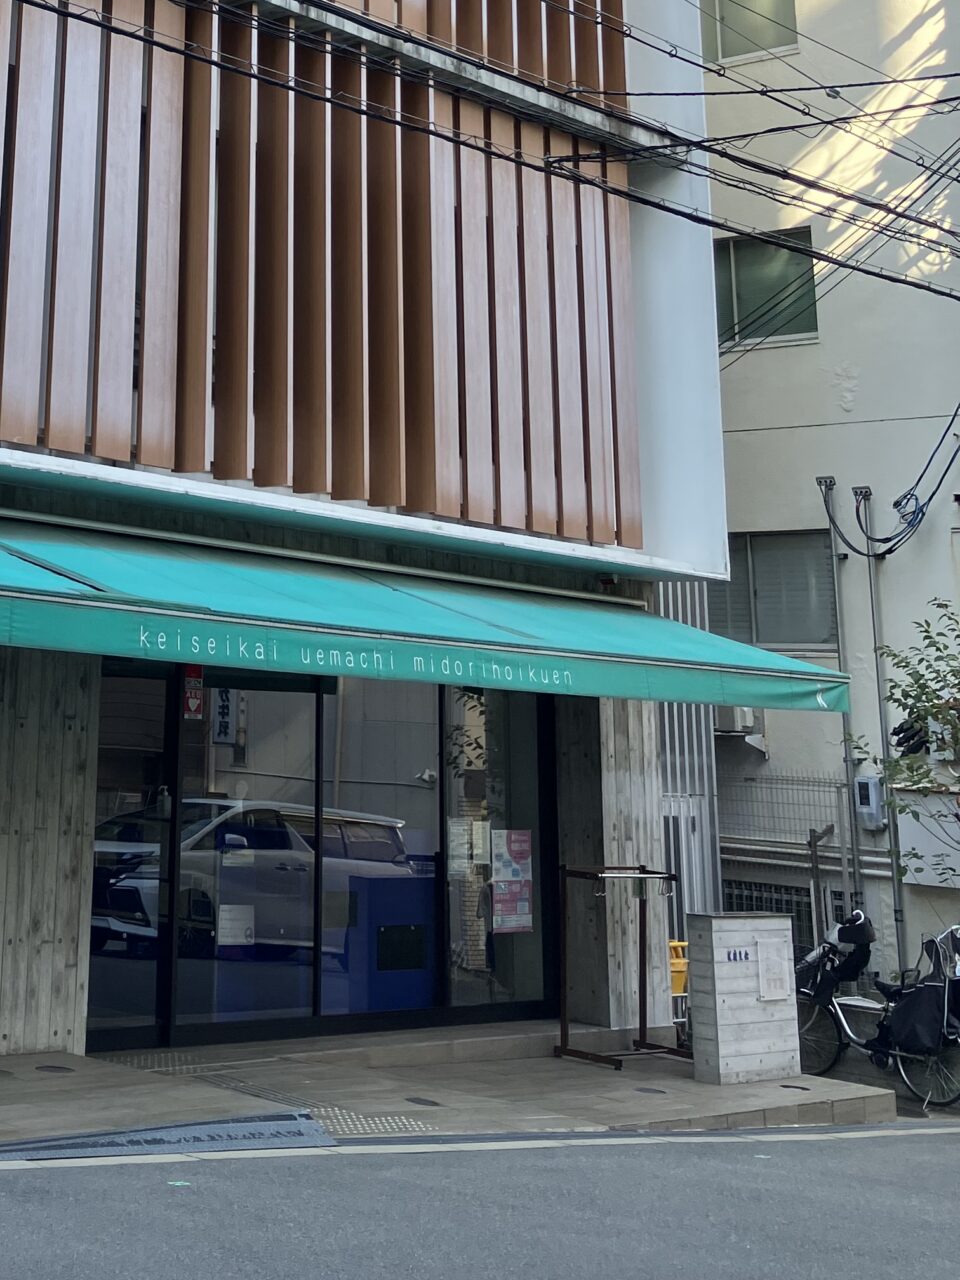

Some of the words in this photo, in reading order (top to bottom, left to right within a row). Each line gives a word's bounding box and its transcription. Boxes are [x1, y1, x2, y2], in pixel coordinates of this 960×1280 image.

[140, 625, 278, 661] keiseikai
[301, 647, 394, 670] uemachi
[185, 689, 201, 699] AED
